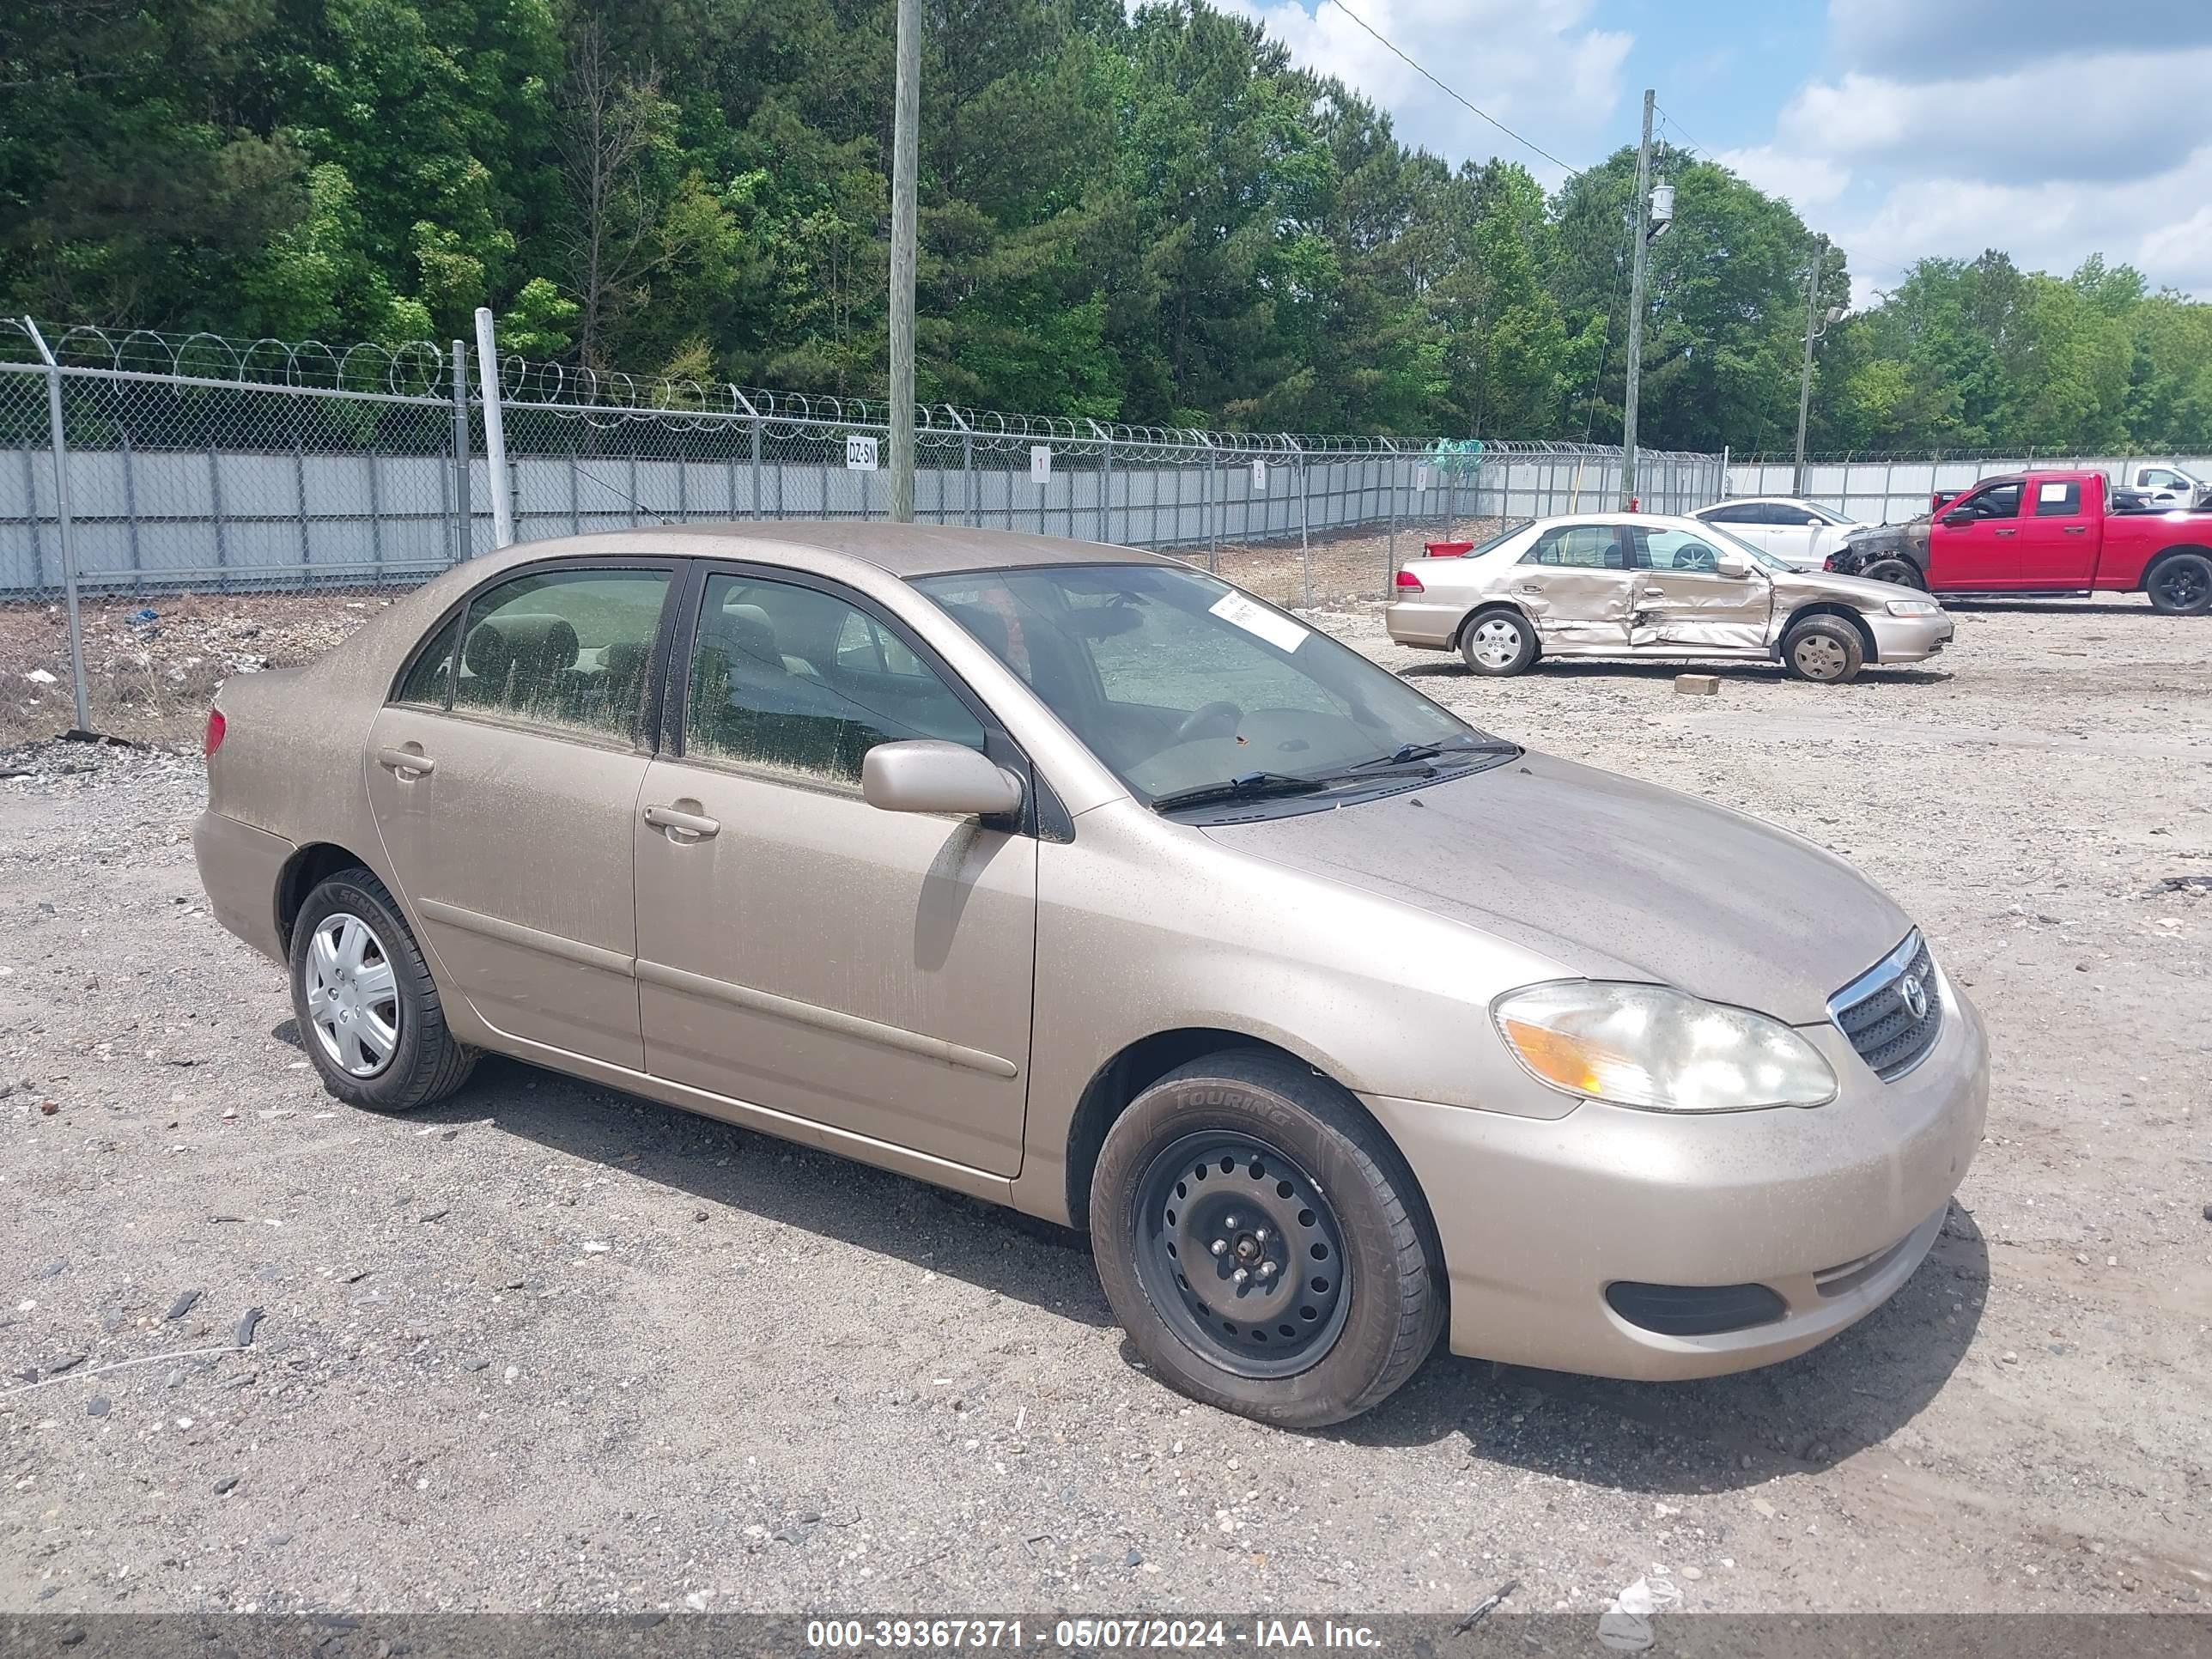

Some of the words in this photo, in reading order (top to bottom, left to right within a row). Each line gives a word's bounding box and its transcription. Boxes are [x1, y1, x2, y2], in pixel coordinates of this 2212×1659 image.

[849, 442, 875, 465] DZ-SN
[1038, 457, 1043, 471] 1
[1257, 468, 1262, 479] 2
[1176, 1089, 1291, 1127] TOURING
